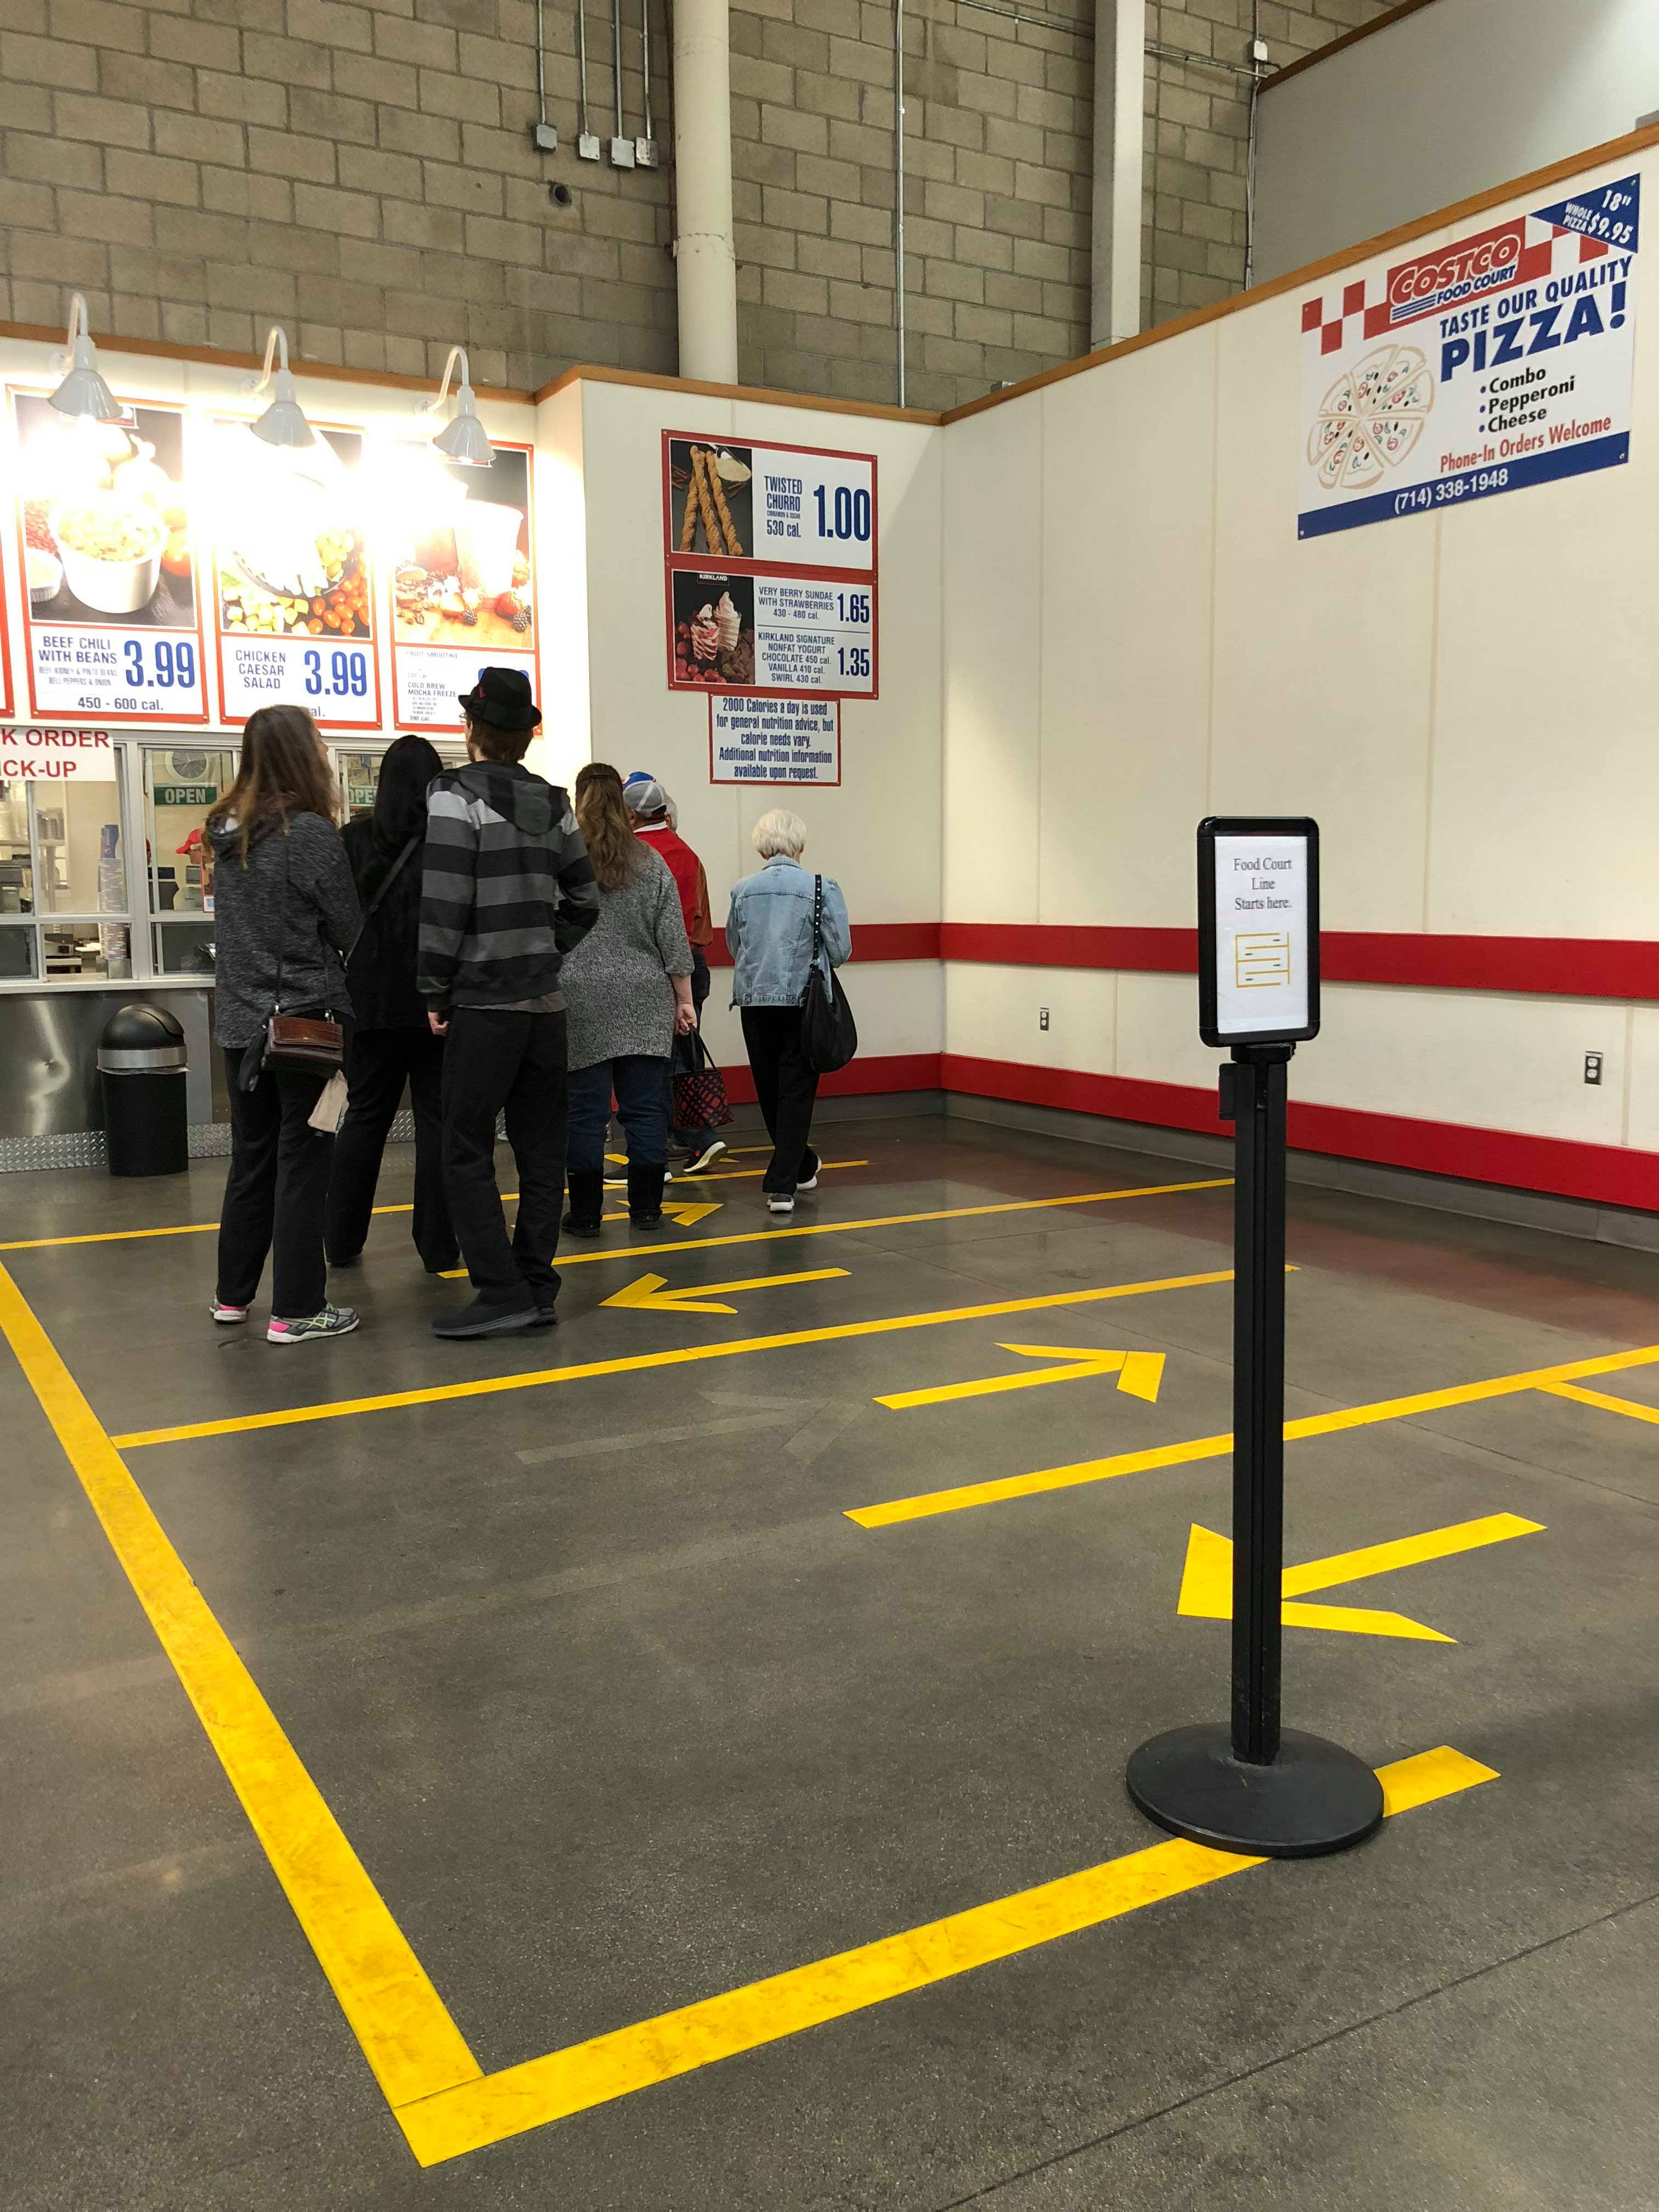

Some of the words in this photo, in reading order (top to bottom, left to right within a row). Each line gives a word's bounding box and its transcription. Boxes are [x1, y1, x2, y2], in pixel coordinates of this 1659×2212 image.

[1602, 189, 1632, 211] 18"
[1565, 202, 1593, 221] WHOLE
[1562, 215, 1587, 232] PIZZA
[1588, 212, 1633, 244] $9.95
[1390, 234, 1521, 306] COSTCO
[1437, 283, 1471, 304] FOOD
[1474, 264, 1516, 290] COURT
[1440, 303, 1489, 338] TASTE
[1497, 289, 1537, 319] OUR
[1545, 255, 1633, 302] QUALITY
[1441, 281, 1626, 383] PIZZA!
[1489, 367, 1546, 394] Combo
[1488, 375, 1576, 415] Pepperoni
[1488, 408, 1547, 433] Cheese
[1440, 444, 1495, 473] Phone-In
[1500, 434, 1545, 458] Orders
[1548, 416, 1611, 445] Welcome
[1394, 489, 1432, 515] (714)
[1436, 468, 1509, 501] 338-1948
[764, 476, 802, 494] TWISTED
[813, 484, 870, 541] 1.00
[766, 493, 800, 511] CHURRO
[766, 520, 784, 536] 530
[787, 522, 801, 538] cal.
[758, 597, 777, 606] WITH
[780, 599, 834, 611] STRAWBERRIES
[759, 587, 777, 596] VERY
[780, 588, 803, 598] BERRY
[805, 590, 833, 600] SUNDAE
[837, 592, 870, 624] 1.65
[773, 609, 786, 617] 430
[793, 610, 806, 618] 480
[808, 612, 820, 620] cal.
[758, 632, 794, 642] KIRKLAND
[796, 634, 835, 645] SIGNATURE
[38, 650, 72, 662] WITH
[76, 652, 117, 664] BEANS
[43, 636, 74, 648] BEEF
[80, 637, 110, 650] CHILI
[124, 640, 195, 688] 3.99
[762, 652, 803, 663] CHOCOLATE
[805, 656, 817, 664] 450
[820, 657, 831, 665] cal.
[768, 643, 795, 653] NONFAT
[798, 645, 826, 654] YOGURT
[838, 647, 870, 677] 1.35
[236, 650, 285, 663] CHICKEN
[304, 650, 367, 696] 3.99
[239, 663, 284, 676] CAESAR
[769, 663, 798, 673] VANILLA
[799, 665, 811, 673] 410
[814, 666, 825, 674] cal.
[244, 677, 280, 689] SALAD
[771, 673, 794, 682] SWIRL
[797, 675, 809, 683] 430
[78, 697, 101, 709] 450
[114, 698, 137, 709] 600
[142, 699, 163, 710] cal.
[310, 706, 325, 716] al.
[723, 698, 743, 712] 2000
[747, 698, 778, 713] Calories
[780, 703, 785, 713] a
[787, 701, 799, 716] day
[802, 702, 808, 714] is
[810, 703, 827, 715] used
[716, 714, 728, 727] for
[731, 715, 759, 730] general
[761, 716, 793, 730] nutrition
[795, 718, 820, 733] advice,
[822, 719, 833, 732] but
[26, 729, 110, 748] ORDER
[741, 732, 768, 745] calorie
[770, 733, 791, 746] needs
[793, 735, 811, 749] vary.
[719, 747, 755, 761] Additional
[758, 749, 789, 763] nutrition
[792, 749, 832, 764] information
[0, 759, 77, 777] CK-UP
[734, 764, 767, 778] available
[770, 767, 787, 780] upon
[789, 766, 818, 781] request.
[164, 788, 206, 804] OPEN
[1233, 857, 1261, 871] Food
[1263, 857, 1292, 870] Court
[1251, 877, 1276, 890] Line
[1235, 898, 1264, 910] Starts
[1267, 896, 1291, 909] here.
